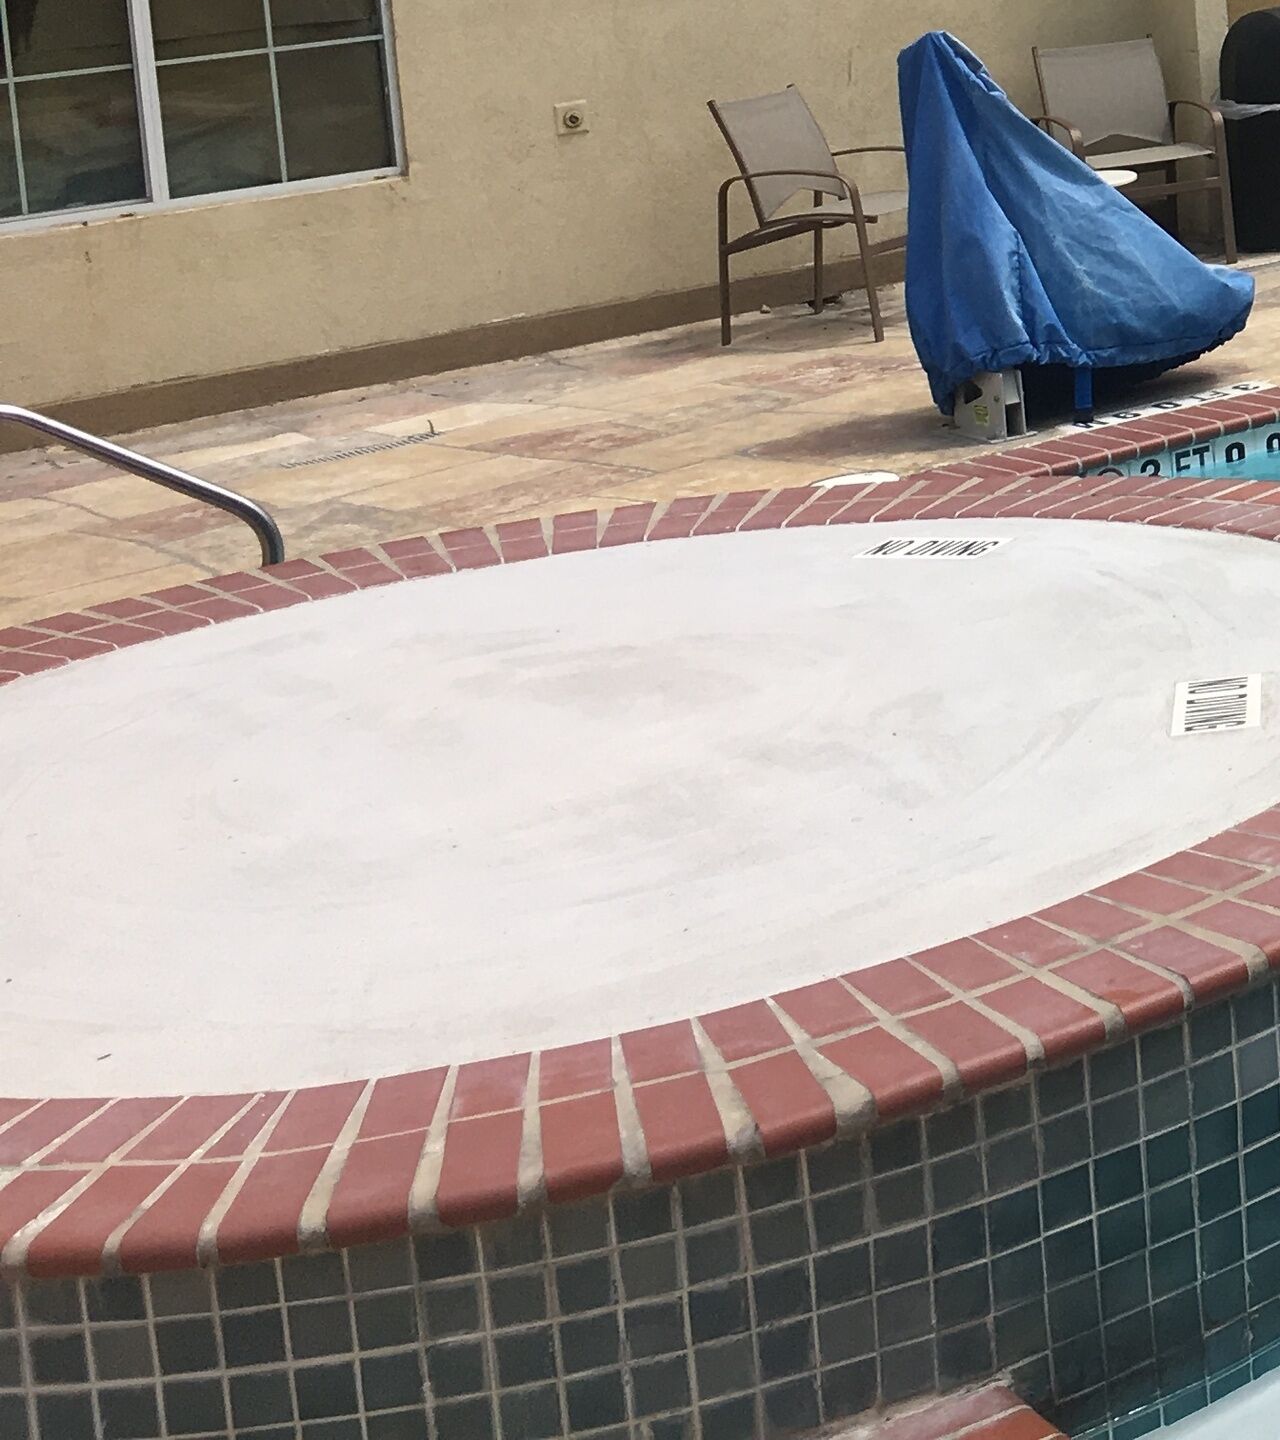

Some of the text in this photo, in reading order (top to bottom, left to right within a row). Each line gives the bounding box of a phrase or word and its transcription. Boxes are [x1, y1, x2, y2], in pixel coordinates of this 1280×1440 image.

[1174, 445, 1210, 472] FT
[863, 540, 999, 556] NO DIVING
[1184, 676, 1248, 732] NO DIVING
